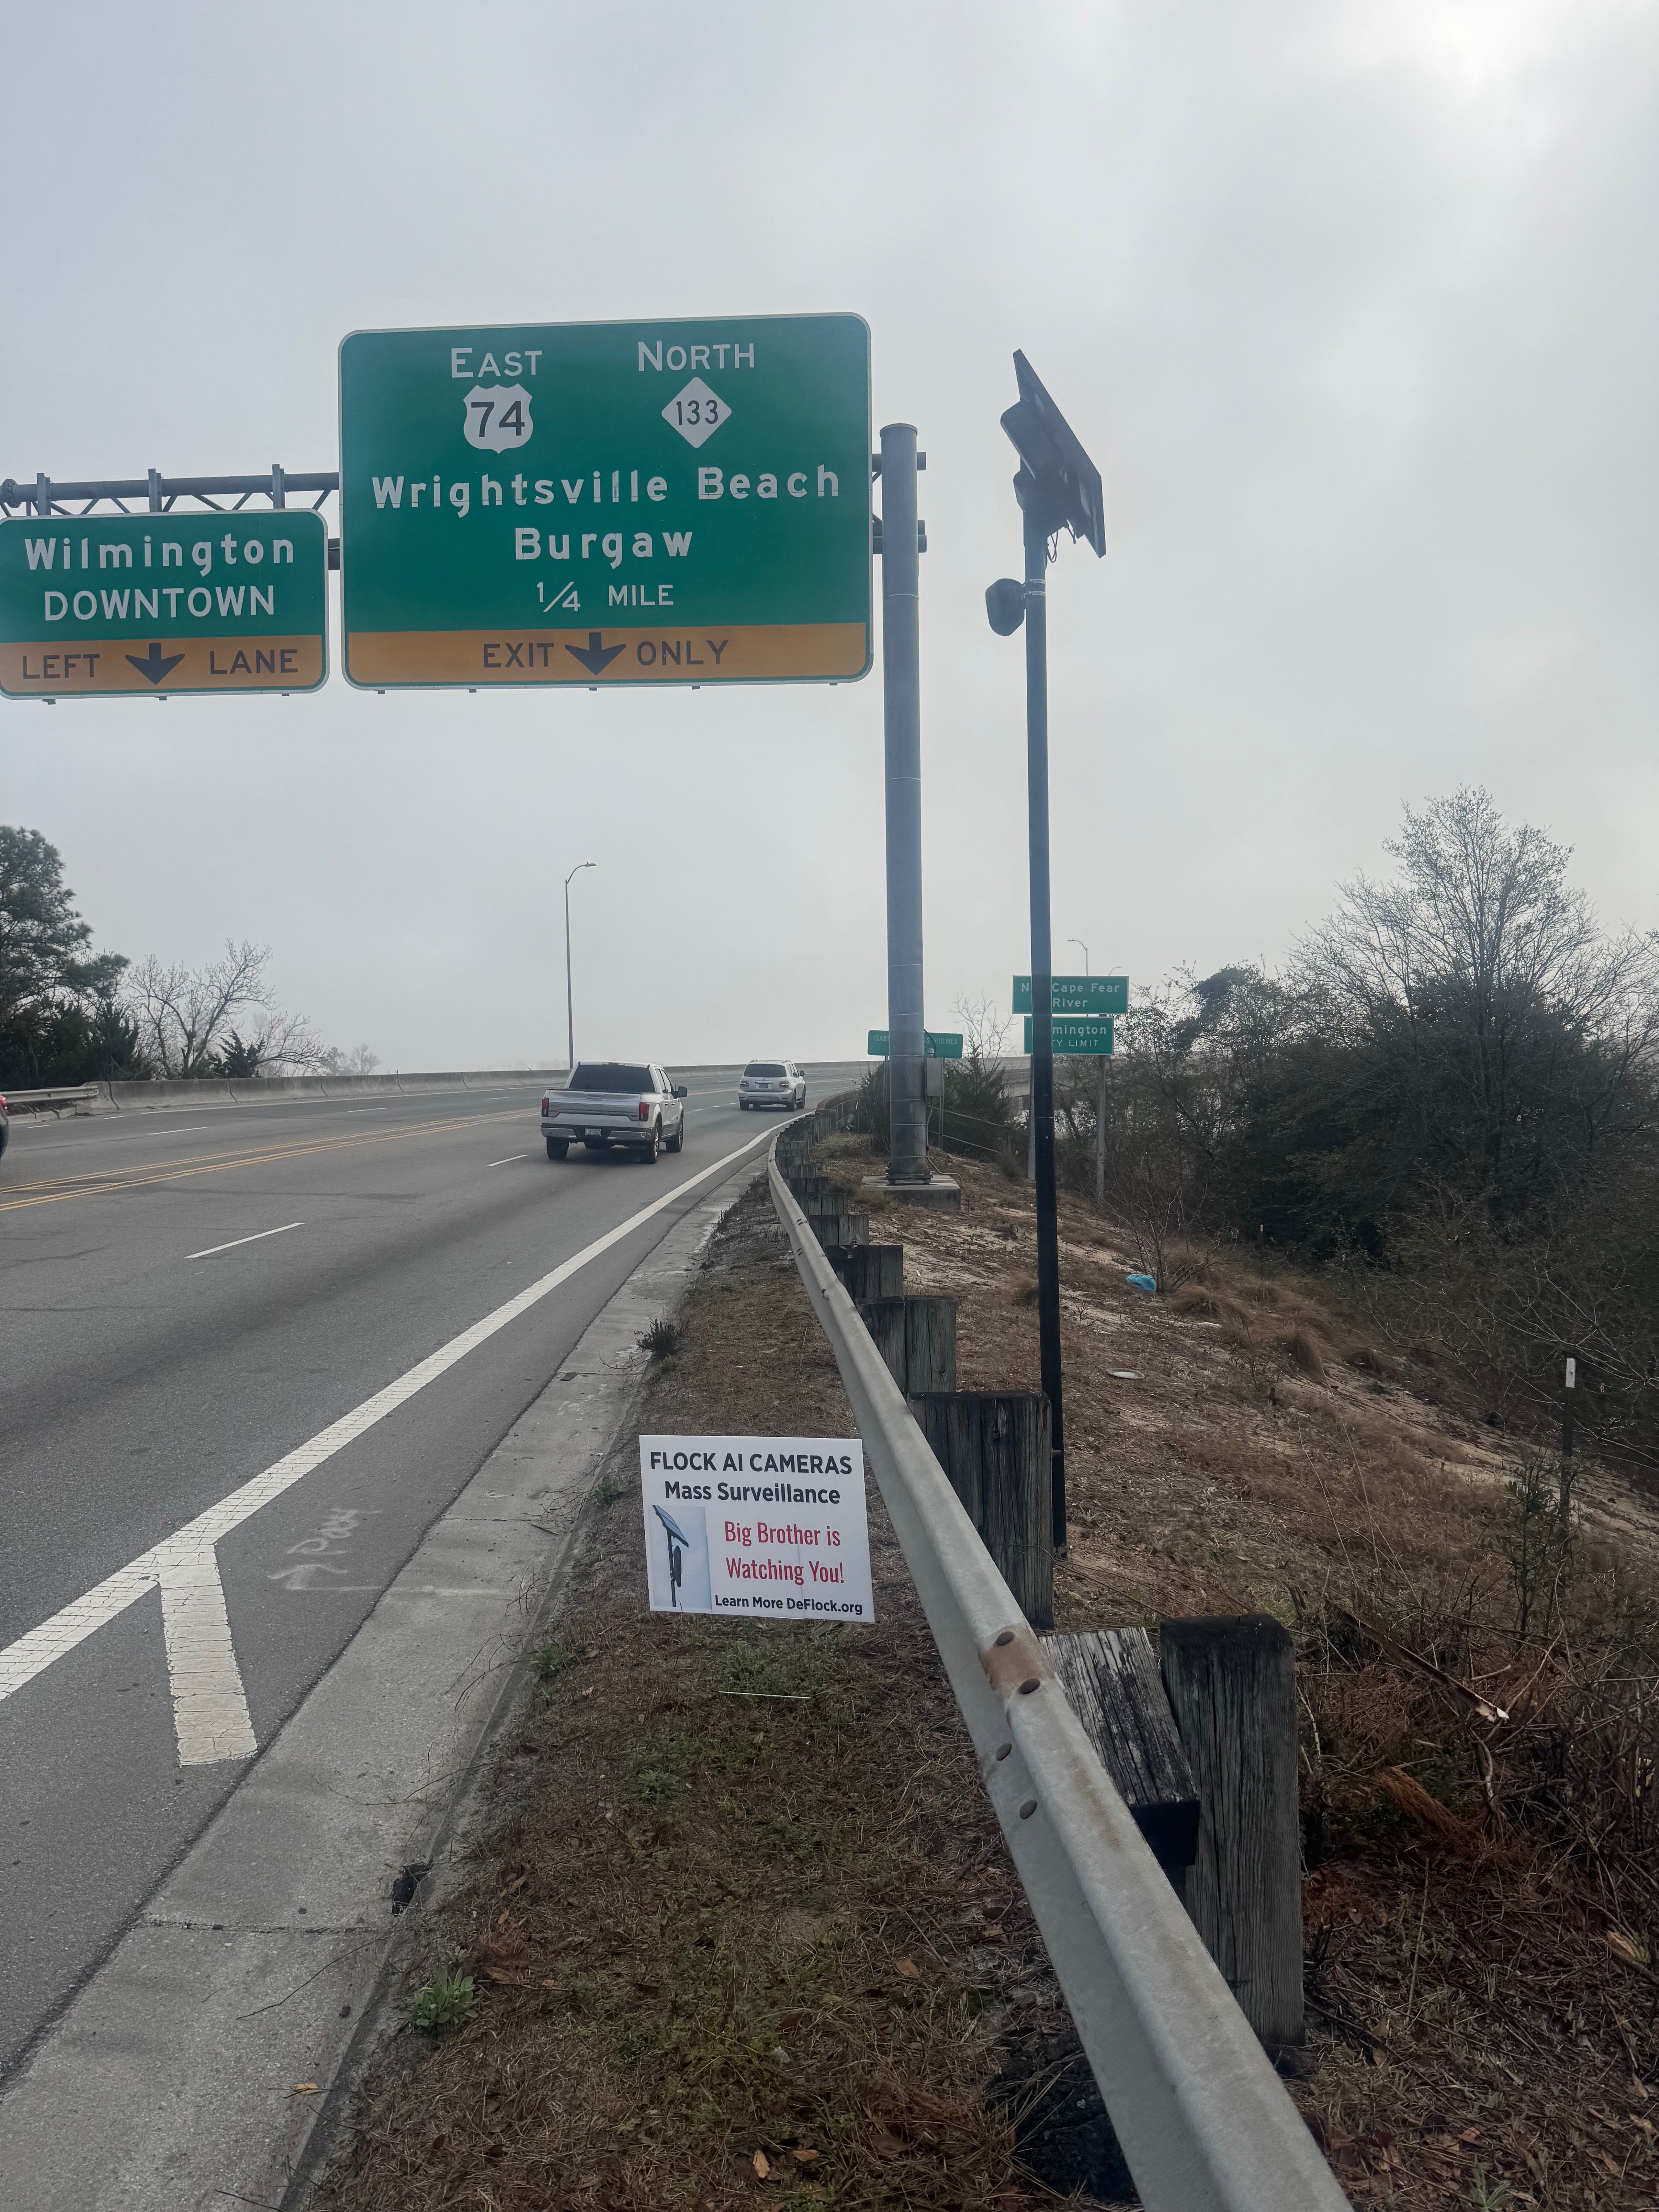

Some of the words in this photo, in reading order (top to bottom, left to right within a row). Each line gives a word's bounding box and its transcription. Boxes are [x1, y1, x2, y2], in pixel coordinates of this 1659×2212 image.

[451, 347, 543, 378] EAST
[637, 341, 756, 372] NORTH
[469, 400, 525, 438] 74
[675, 400, 720, 425] 133
[371, 470, 669, 518] Wrightsville
[697, 464, 840, 500] Beach
[24, 533, 294, 577] Wilmington
[515, 527, 693, 568] Burgaw
[45, 585, 274, 621] DOWNTOWN
[608, 584, 674, 606] MILE
[22, 653, 100, 680] LEFT
[210, 649, 298, 675] LANE
[483, 642, 554, 668] EXIT
[636, 639, 730, 666] ONLY
[1052, 983, 1084, 994] Cape
[1091, 983, 1120, 992] Fear
[1053, 998, 1087, 1007] River
[1053, 1025, 1107, 1037] mington
[650, 1452, 717, 1471] FLOCK
[723, 1453, 743, 1471] AI
[749, 1453, 852, 1475] CAMERAS
[665, 1481, 712, 1500] Mass
[717, 1482, 841, 1504] Surveillance
[725, 1521, 752, 1547] Big
[757, 1522, 821, 1546] Brother
[826, 1525, 841, 1547] is
[725, 1557, 804, 1585] Watching
[808, 1560, 844, 1584] You!
[715, 1594, 749, 1608] Learn
[752, 1596, 783, 1609] More
[787, 1597, 863, 1615] DeFlock.org
